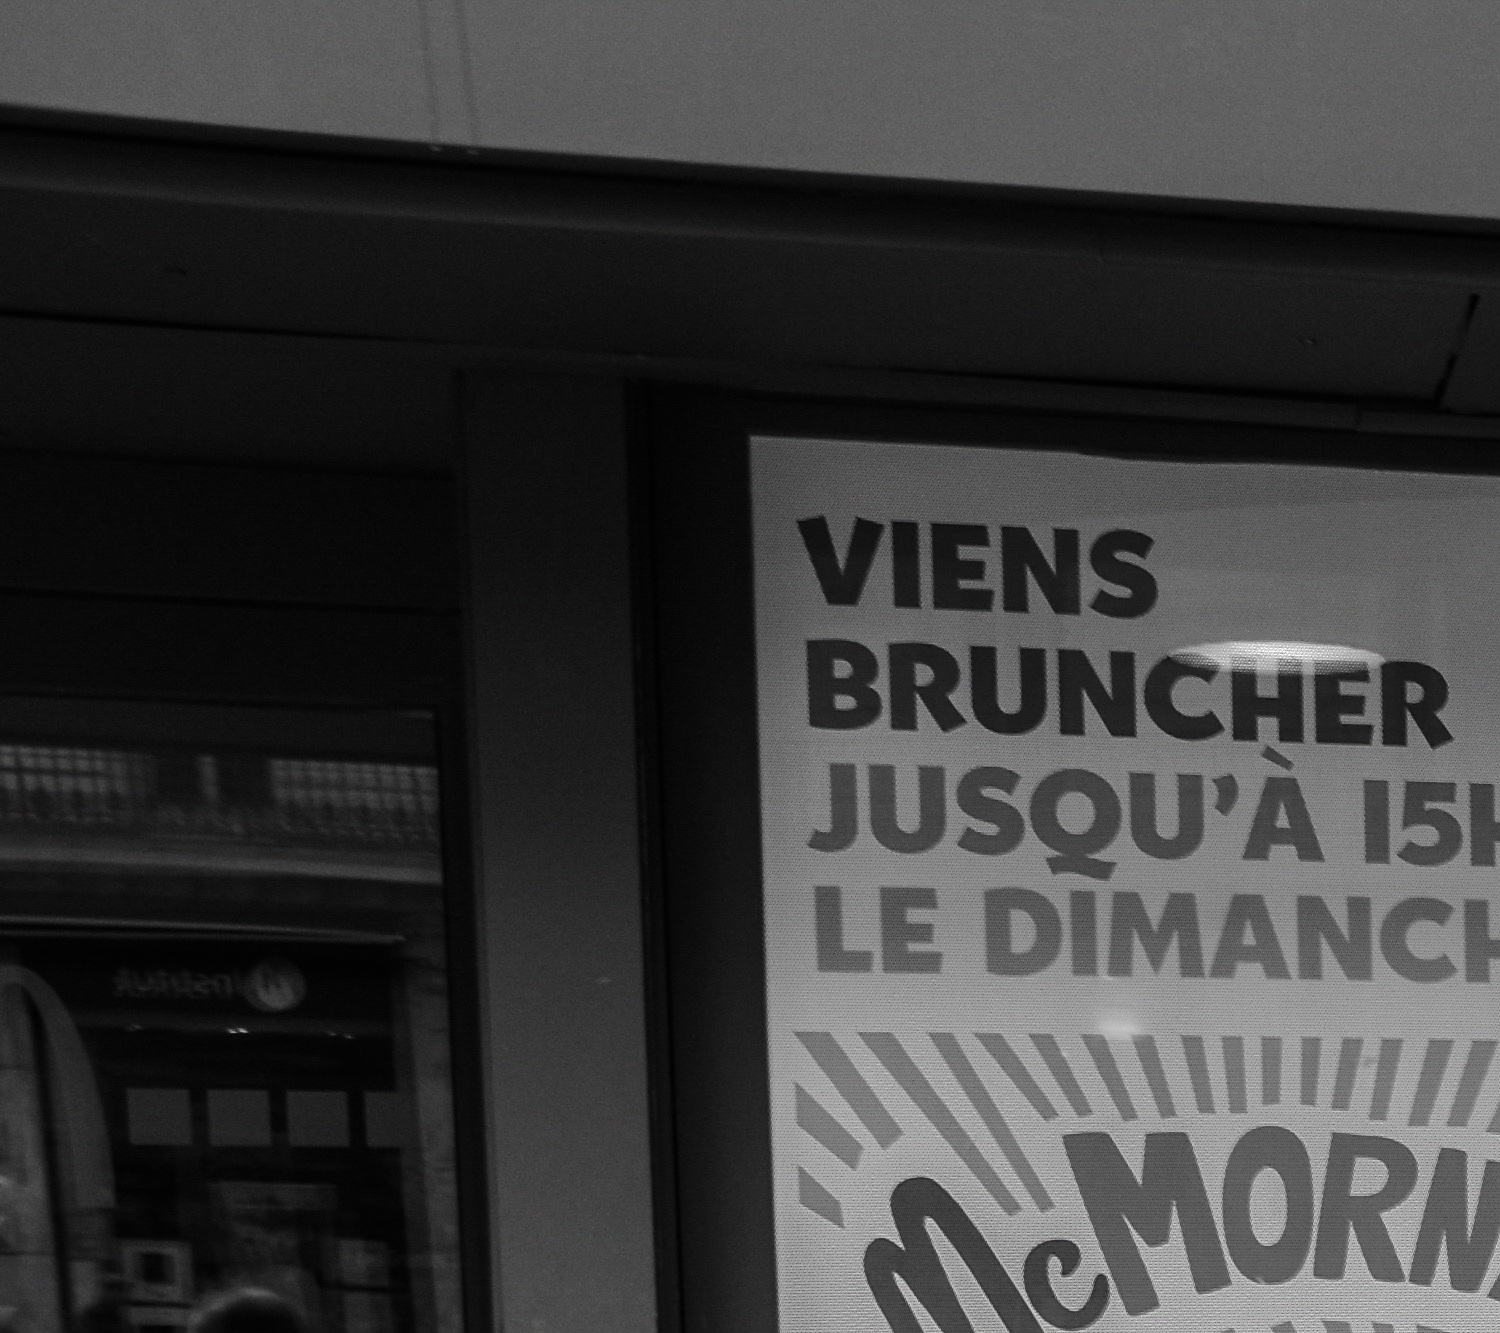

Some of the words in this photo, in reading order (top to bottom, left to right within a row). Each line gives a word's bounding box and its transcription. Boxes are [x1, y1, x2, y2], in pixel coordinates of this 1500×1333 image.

[797, 514, 1161, 620] VIENS
[804, 638, 1457, 749] BRUNCHER
[806, 745, 1325, 881] JUSQU'À
[813, 885, 944, 974] LE
